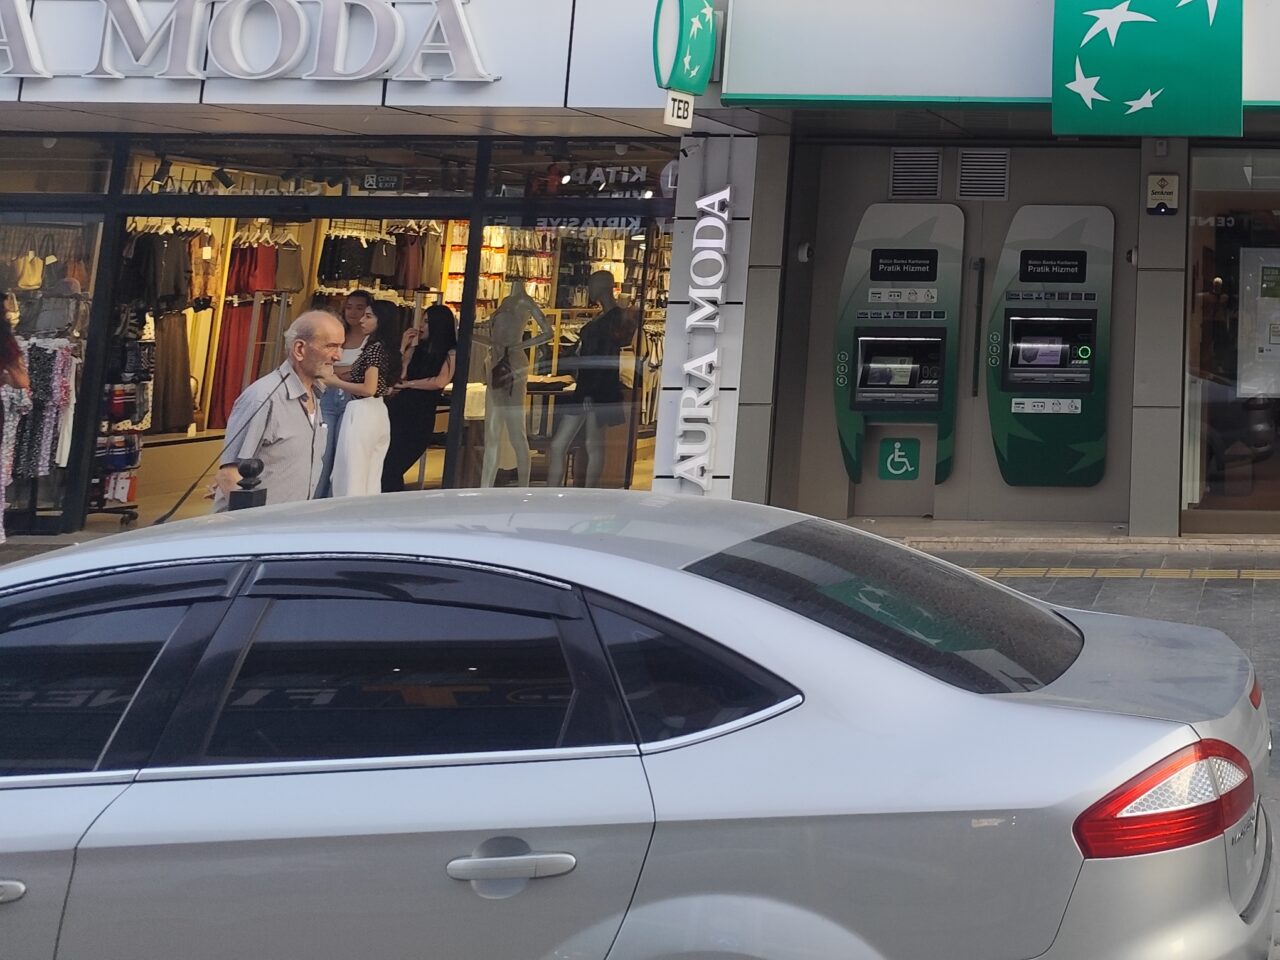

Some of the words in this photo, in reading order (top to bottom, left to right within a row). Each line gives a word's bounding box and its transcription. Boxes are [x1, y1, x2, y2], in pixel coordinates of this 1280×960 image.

[670, 97, 690, 120] TEB
[685, 185, 732, 334] MODA
[878, 264, 901, 273] Pratik
[902, 265, 930, 273] Hizmet
[1028, 265, 1050, 274] Pratik
[1051, 265, 1079, 274] Hizmet
[672, 348, 719, 491] AURA
